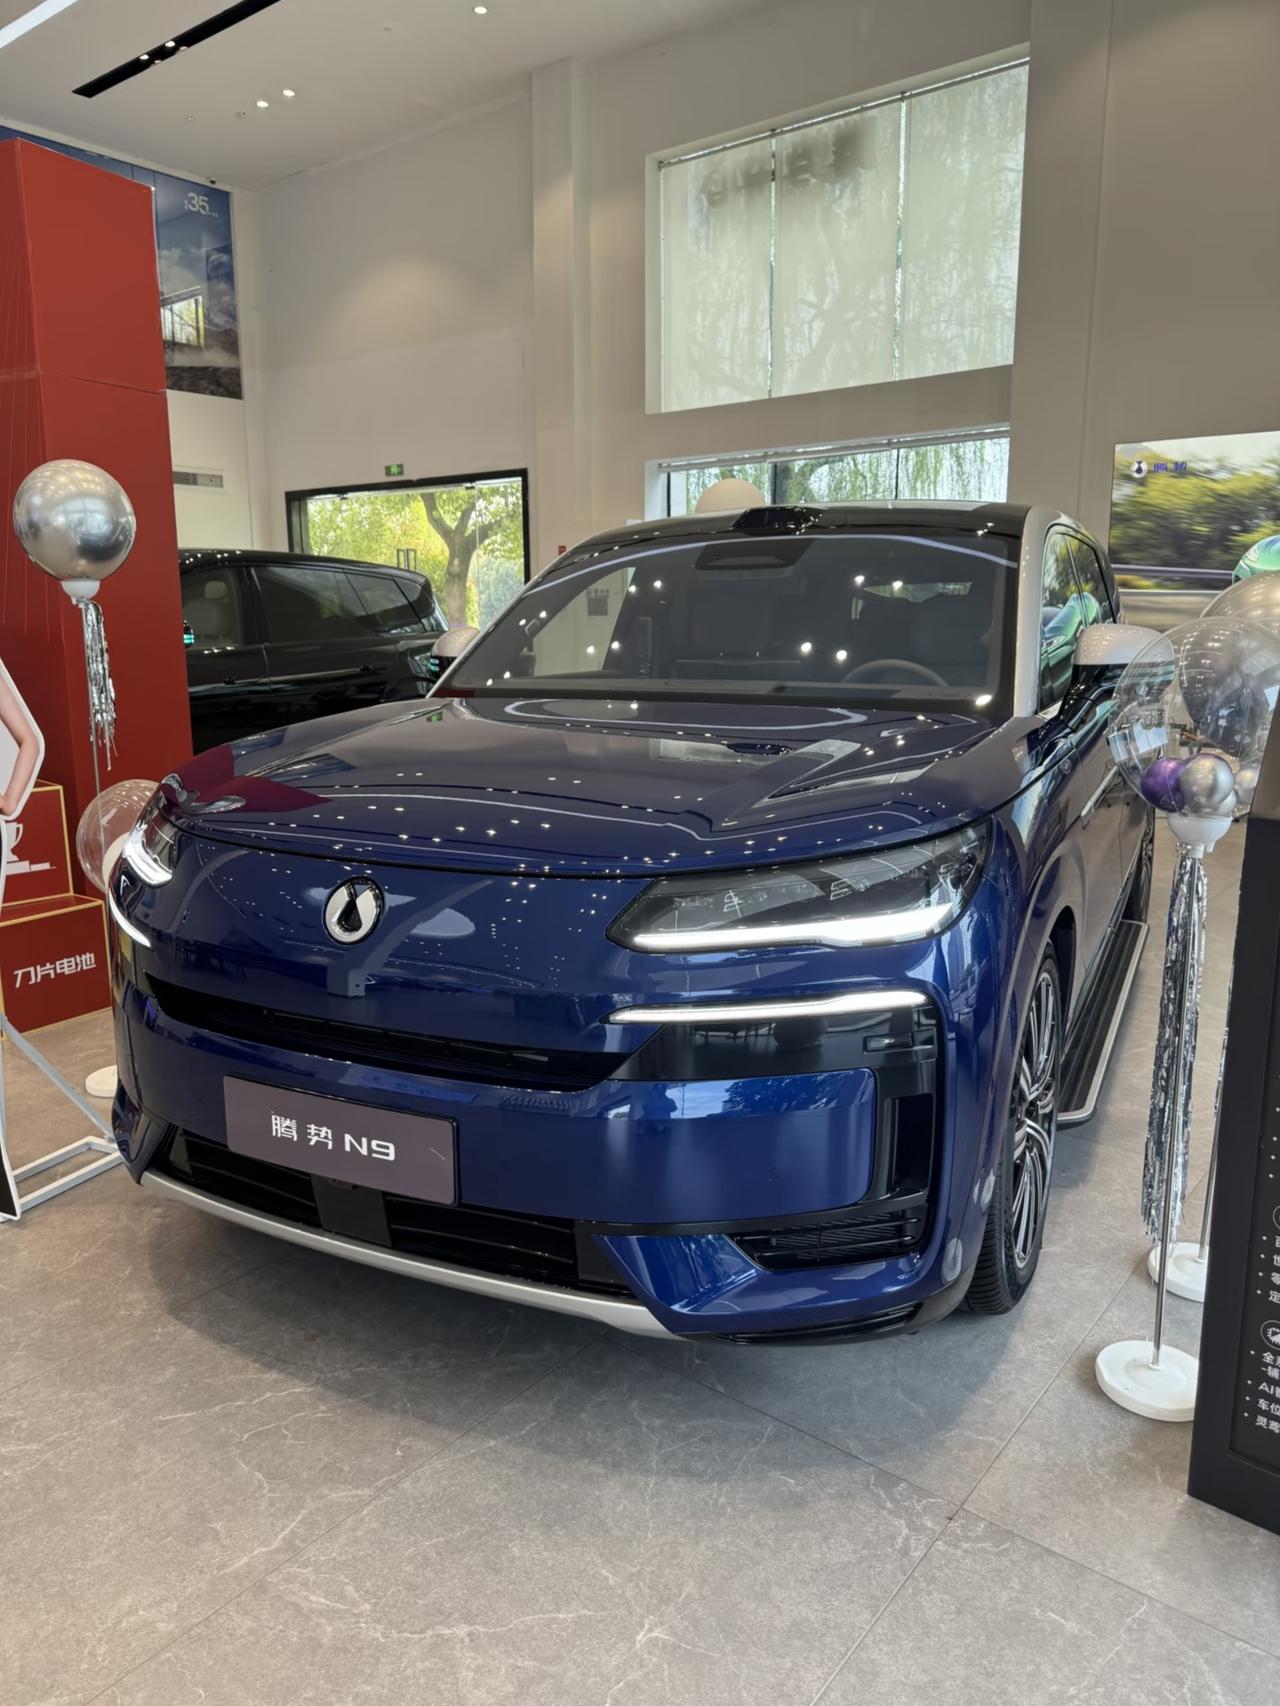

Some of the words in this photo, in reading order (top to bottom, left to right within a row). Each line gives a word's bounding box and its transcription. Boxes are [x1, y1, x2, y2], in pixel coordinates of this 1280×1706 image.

[188, 192, 209, 215] 35
[14, 952, 96, 988] 刀片电池
[344, 1133, 396, 1161] N9
